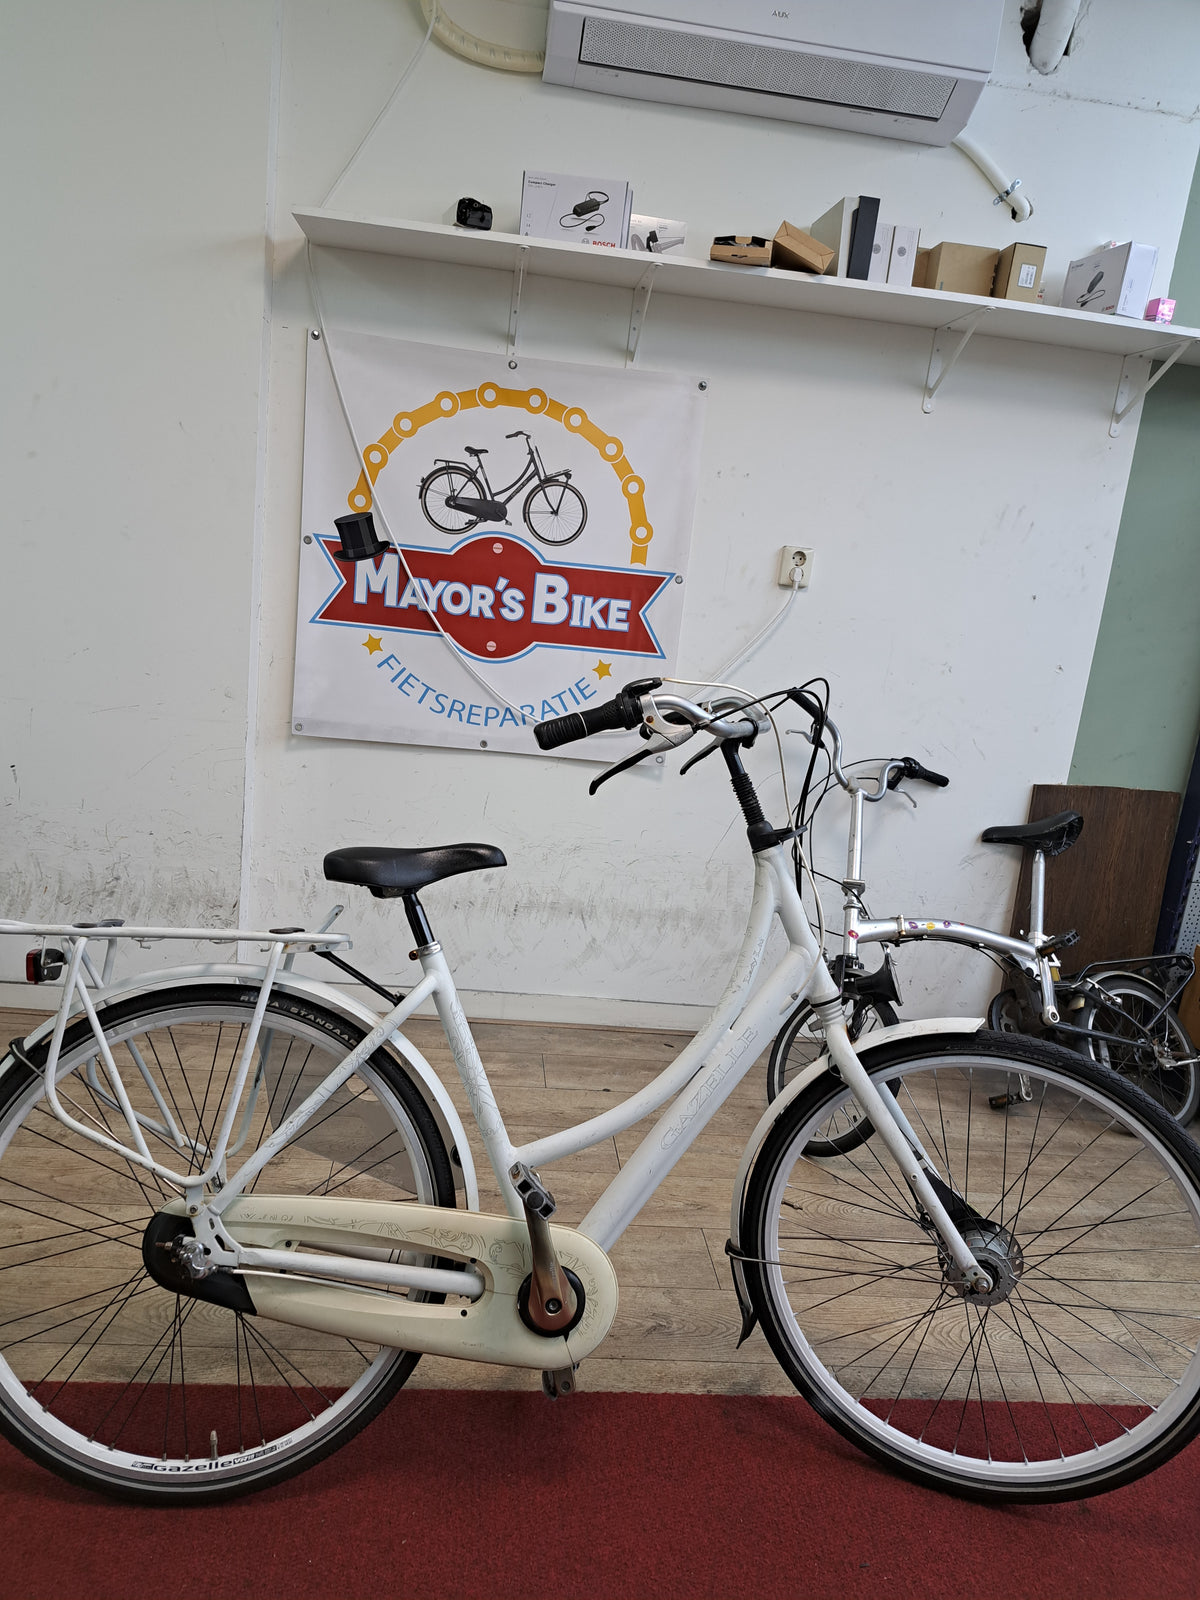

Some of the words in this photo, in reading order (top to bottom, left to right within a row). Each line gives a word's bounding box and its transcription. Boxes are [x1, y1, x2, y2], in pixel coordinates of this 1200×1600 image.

[376, 653, 598, 728] FIETSREPARATIE
[240, 995, 280, 1009] RUA
[290, 1007, 358, 1047] STANDAAR
[660, 1026, 759, 1150] GAZELLE
